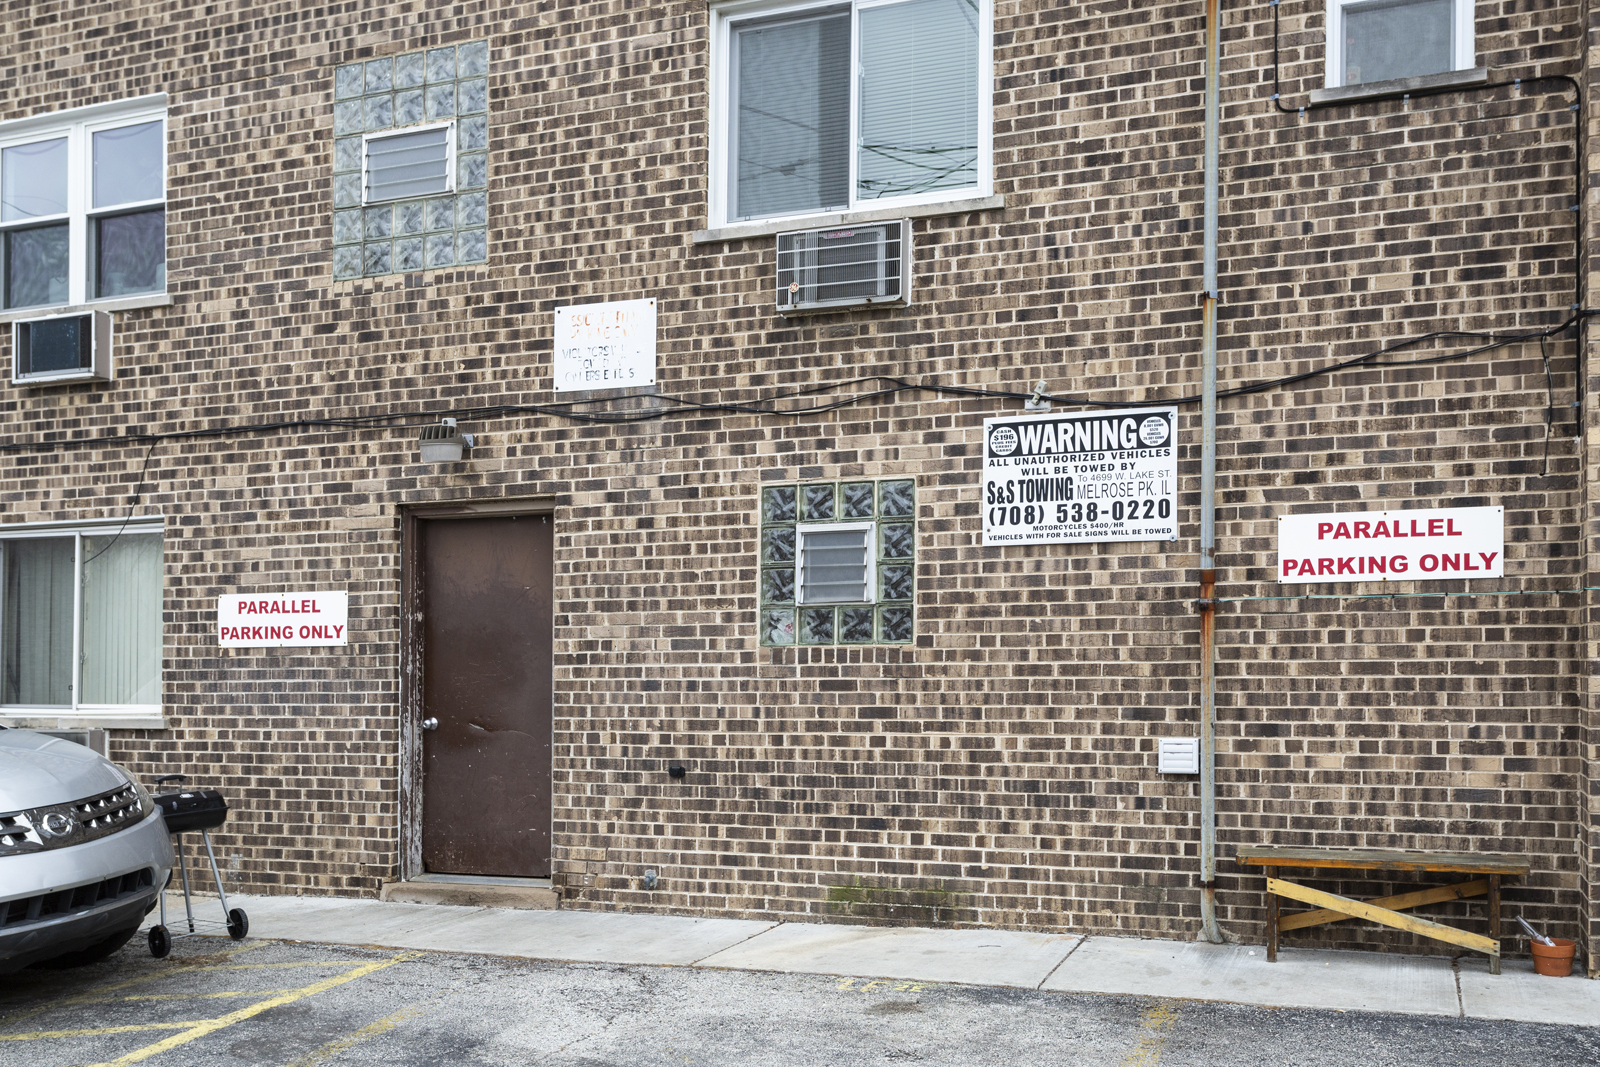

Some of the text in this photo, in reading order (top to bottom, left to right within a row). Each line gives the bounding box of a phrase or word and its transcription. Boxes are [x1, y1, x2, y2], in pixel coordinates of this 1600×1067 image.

[993, 433, 1014, 441] $196
[1018, 418, 1138, 455] WARNING
[988, 448, 1171, 467] ALL UNAUTHORIZED VEHICLES
[1021, 462, 1136, 476] WILL BE TOWED BY
[1090, 473, 1112, 482] 4699
[1115, 472, 1126, 480] W.
[1129, 470, 1154, 480] LAKE
[1157, 469, 1172, 478] ST.
[987, 476, 1074, 505] S&S TOWING
[1077, 480, 1171, 500] MELROSE PK. IL
[989, 498, 1171, 526] (708) 538-0220
[1032, 521, 1124, 531] MOTORCYCLES $400/HR
[1317, 518, 1463, 541] PARALLEL
[988, 533, 1023, 541] VEHICLES
[1282, 551, 1499, 577] PARKING ONLY
[238, 599, 321, 615] PARALLEL
[221, 624, 344, 641] PARKING ONLY
